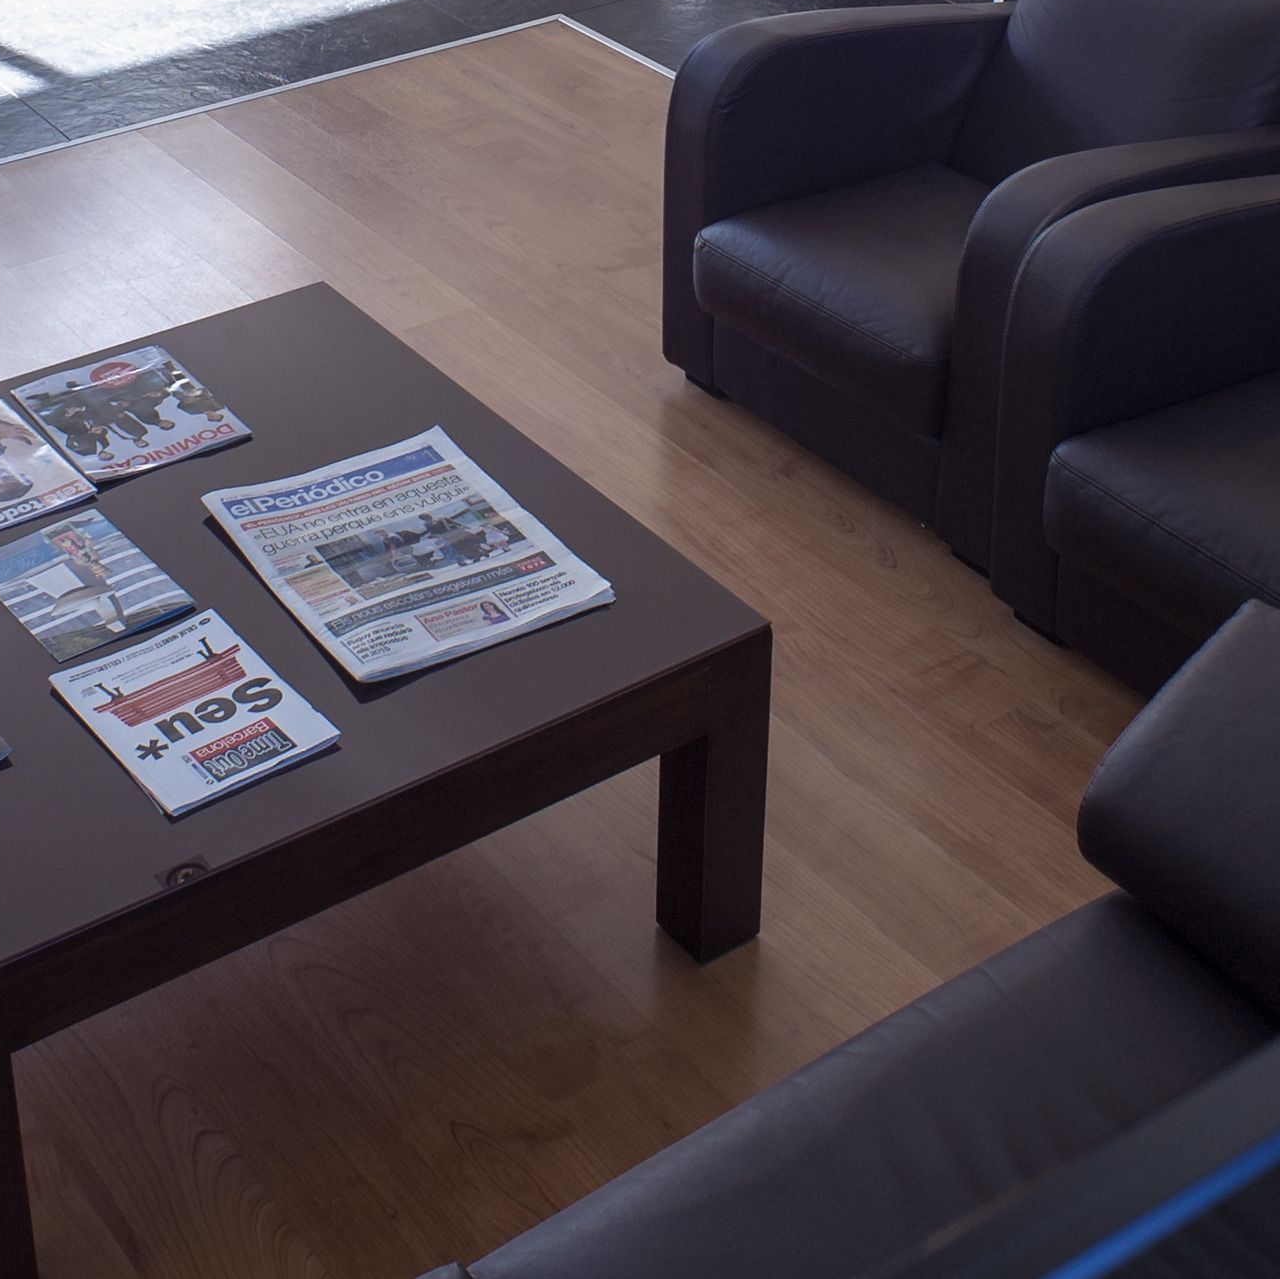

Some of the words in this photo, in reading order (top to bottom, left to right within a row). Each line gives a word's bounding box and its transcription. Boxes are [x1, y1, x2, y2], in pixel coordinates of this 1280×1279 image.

[103, 422, 237, 472] DOMINICAL
[303, 515, 327, 531] no
[327, 503, 371, 525] entra
[372, 496, 395, 511] en
[395, 473, 464, 508] aquesta
[262, 531, 321, 557] guerra
[382, 502, 416, 521] ens
[196, 721, 270, 758] Barcelona
